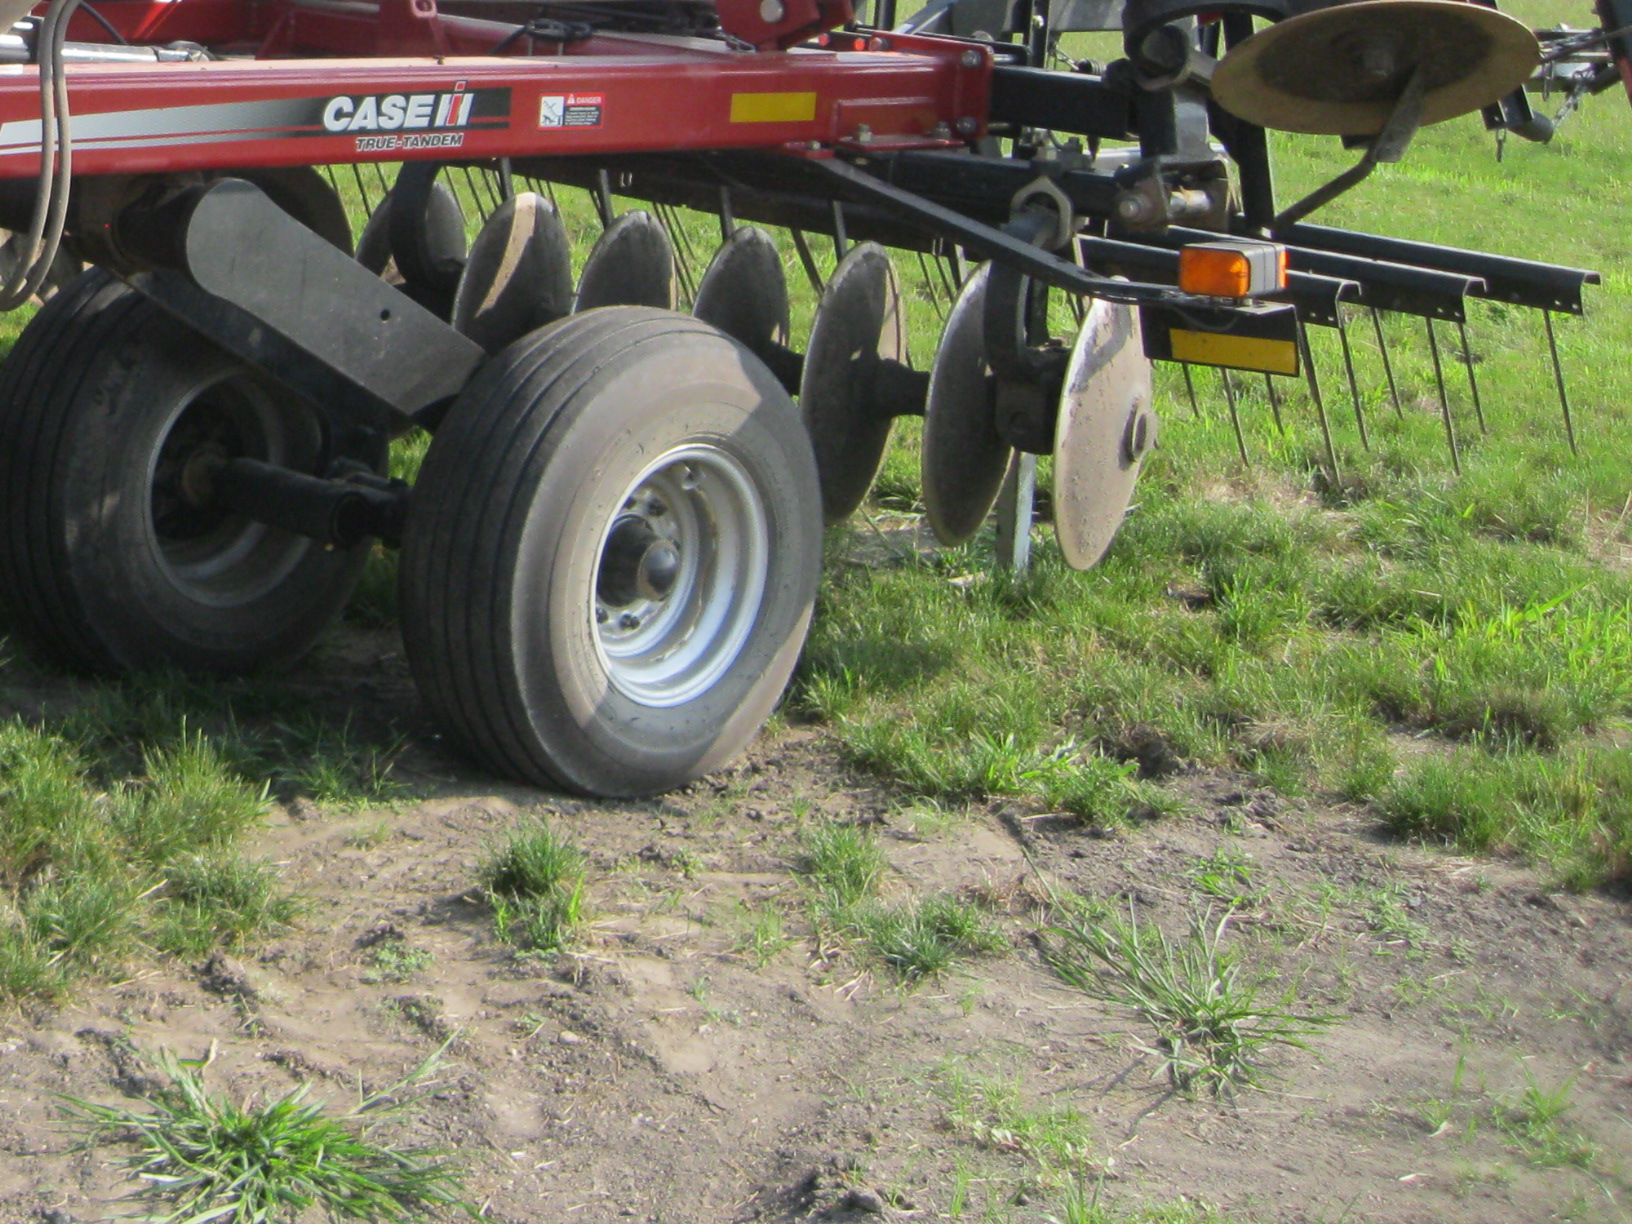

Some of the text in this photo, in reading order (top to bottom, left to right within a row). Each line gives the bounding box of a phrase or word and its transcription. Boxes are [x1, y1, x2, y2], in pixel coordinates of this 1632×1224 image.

[576, 96, 602, 105] DANGER
[323, 93, 436, 132] CASE
[355, 132, 465, 152] TRUE-TANDEM
